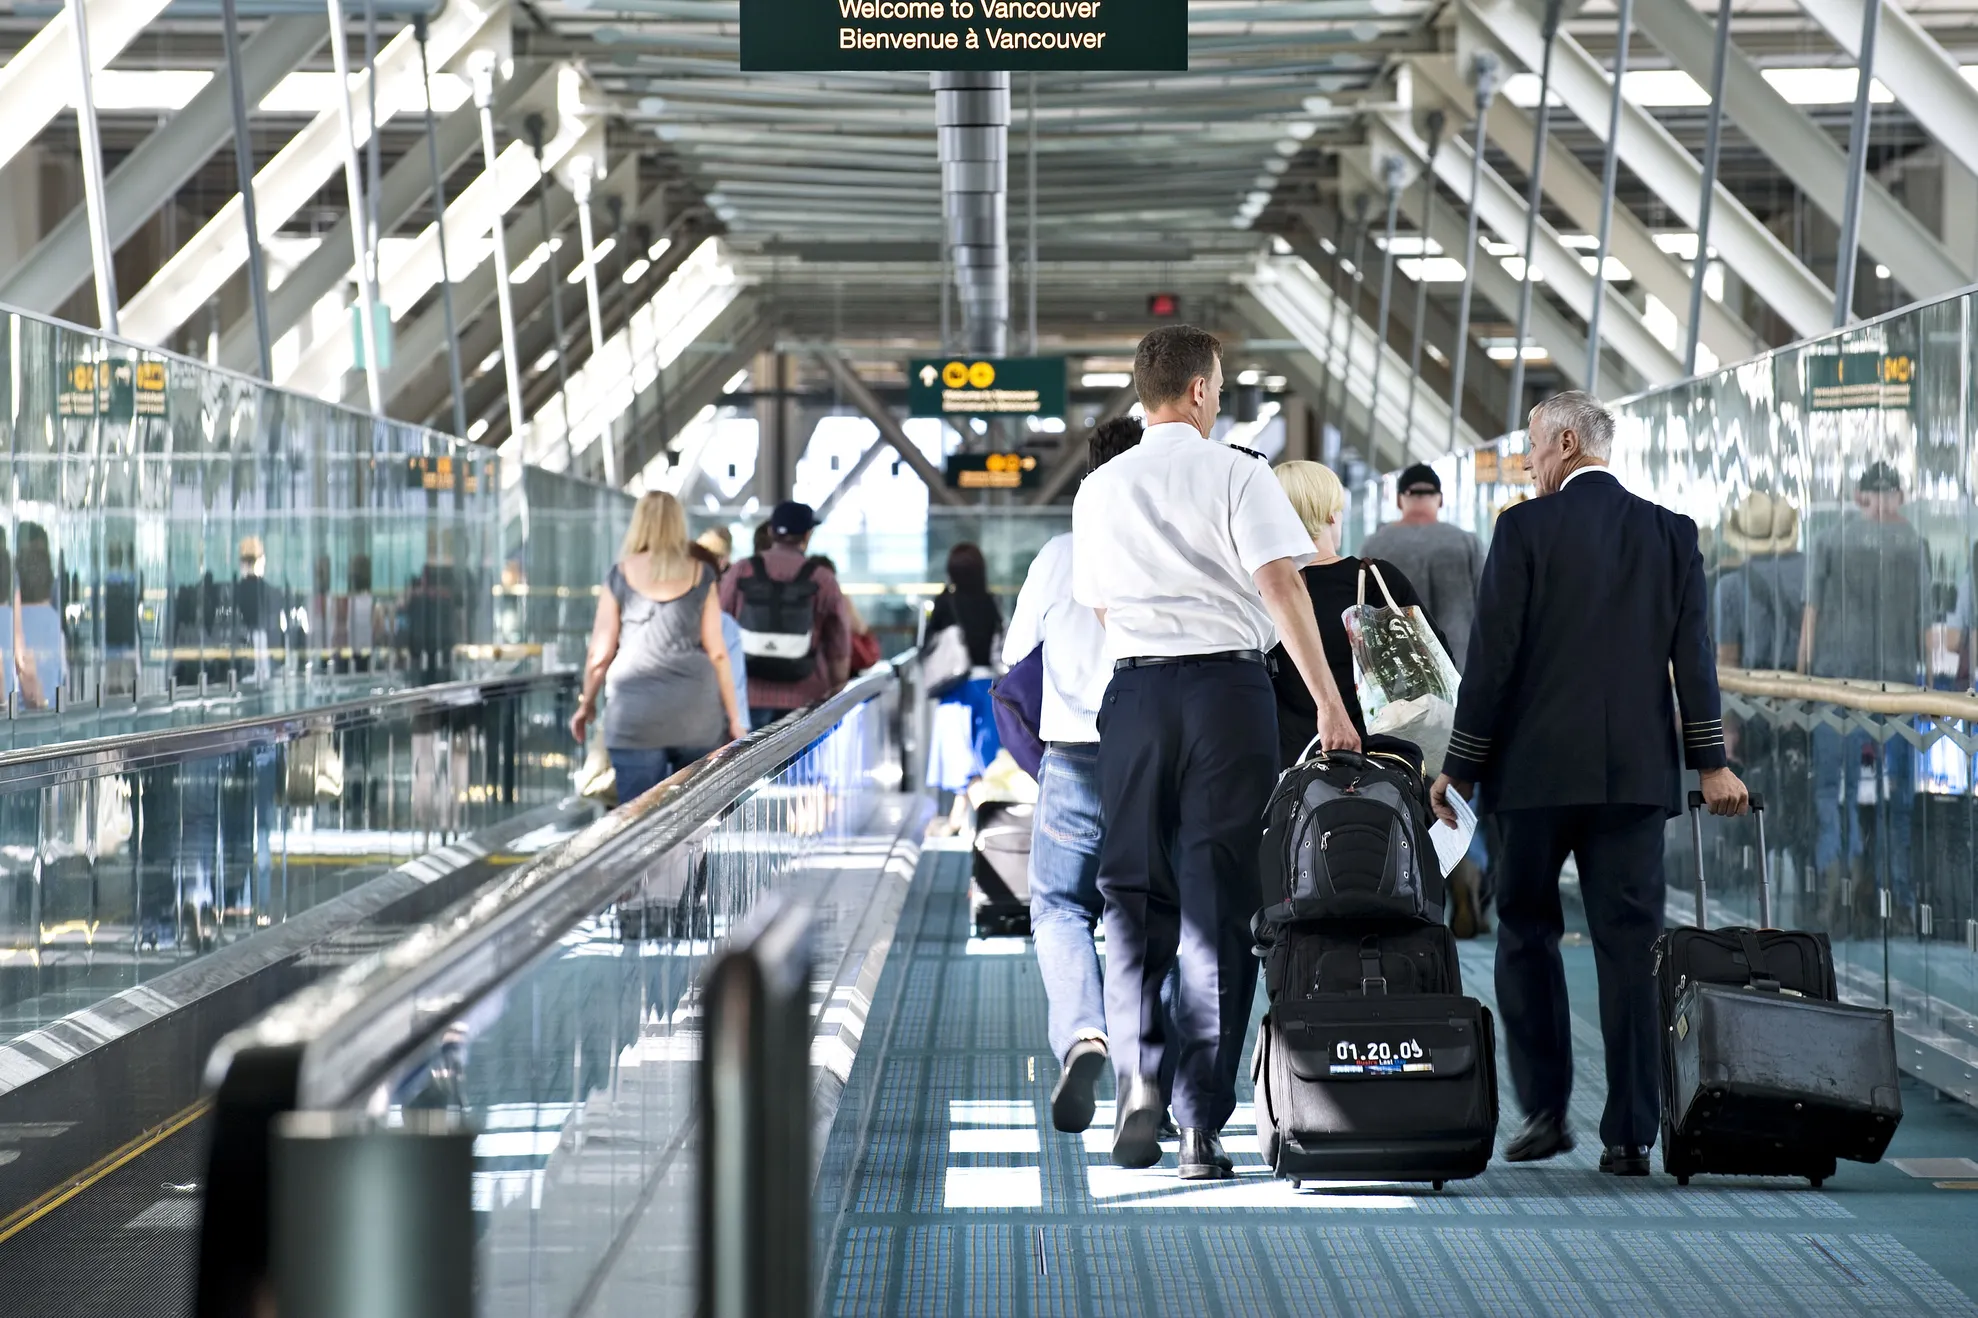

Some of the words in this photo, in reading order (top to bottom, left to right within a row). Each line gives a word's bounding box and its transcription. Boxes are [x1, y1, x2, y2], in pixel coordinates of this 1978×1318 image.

[839, 0, 945, 19] Welcome
[949, 0, 974, 19] to
[980, 0, 1101, 19] Vancouver
[839, 27, 959, 50] Bienvenue
[965, 27, 980, 50] à
[985, 27, 1107, 50] Vancouver
